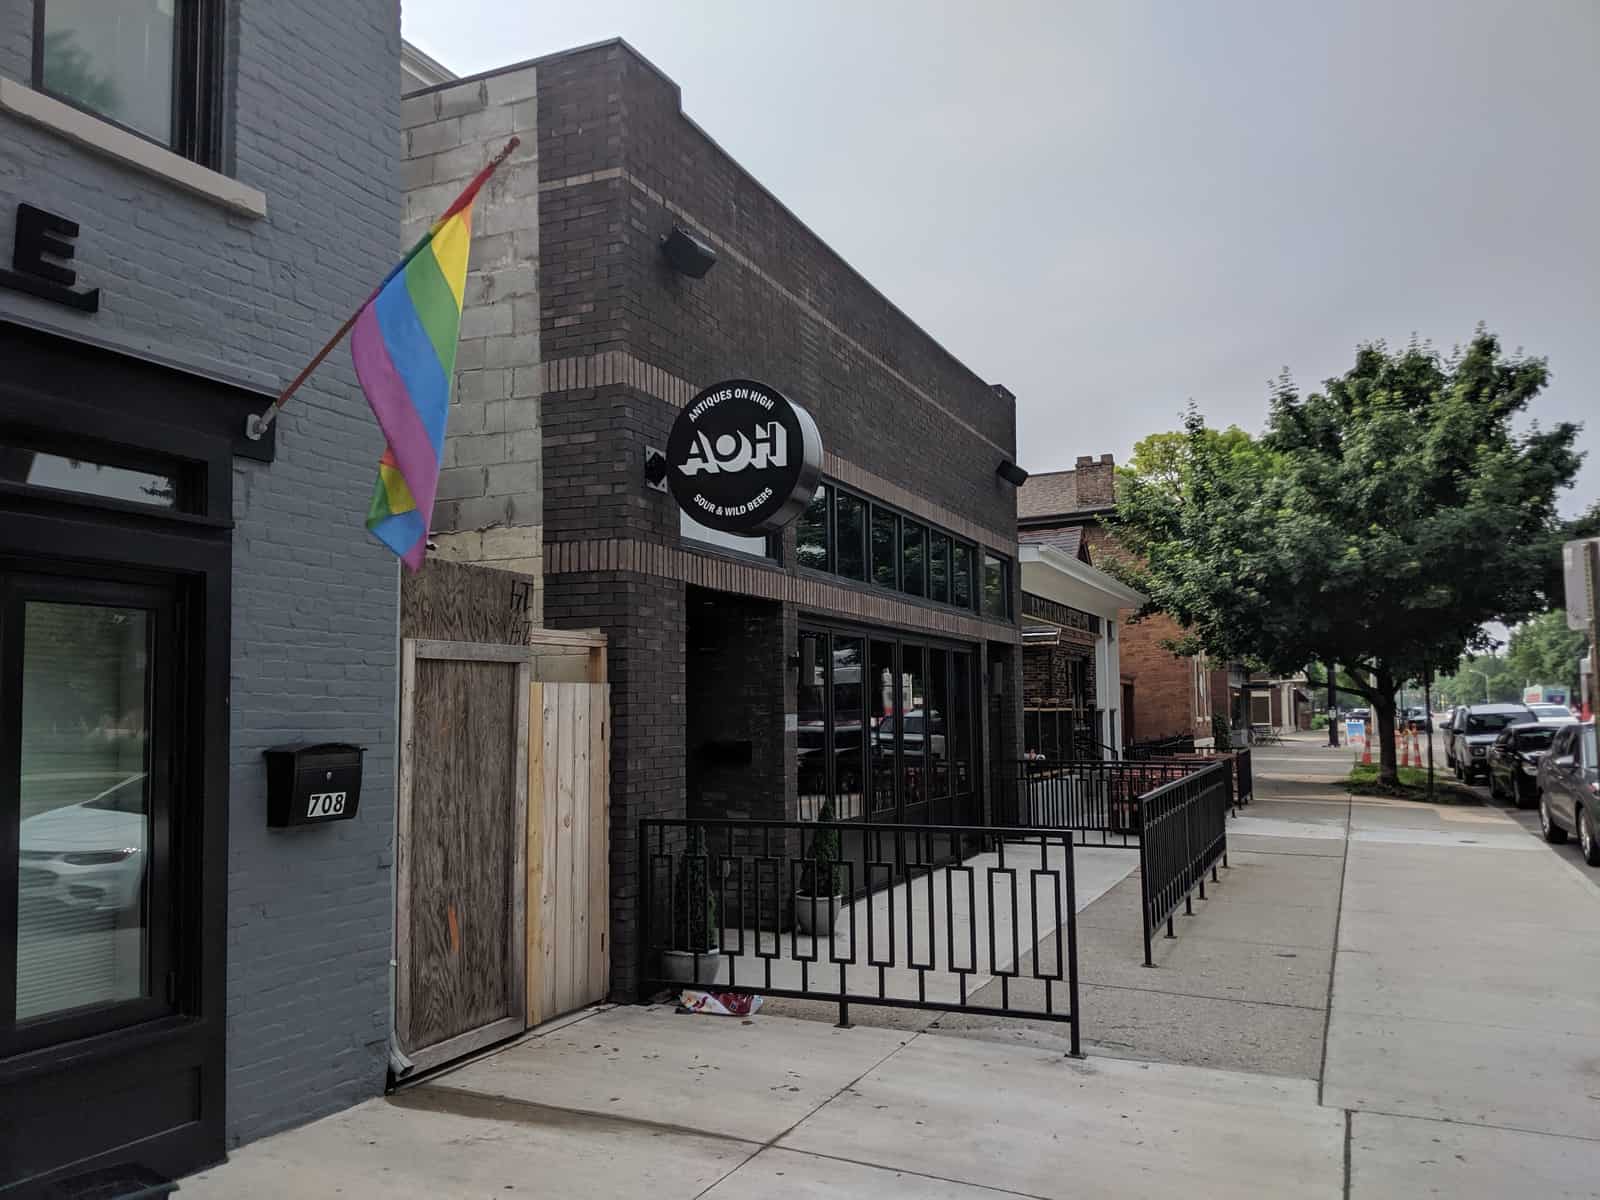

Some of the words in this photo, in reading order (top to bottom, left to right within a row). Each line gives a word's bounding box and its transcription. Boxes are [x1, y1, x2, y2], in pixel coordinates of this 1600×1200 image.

[688, 389, 732, 422] ANTIQUES
[734, 388, 749, 399] ON
[750, 390, 775, 410] HIGH
[678, 421, 788, 476] AOH
[694, 493, 716, 513] SOUR
[715, 506, 723, 516] &
[725, 505, 746, 516] WILD
[747, 487, 773, 511] BEERS
[309, 794, 344, 815] 708
